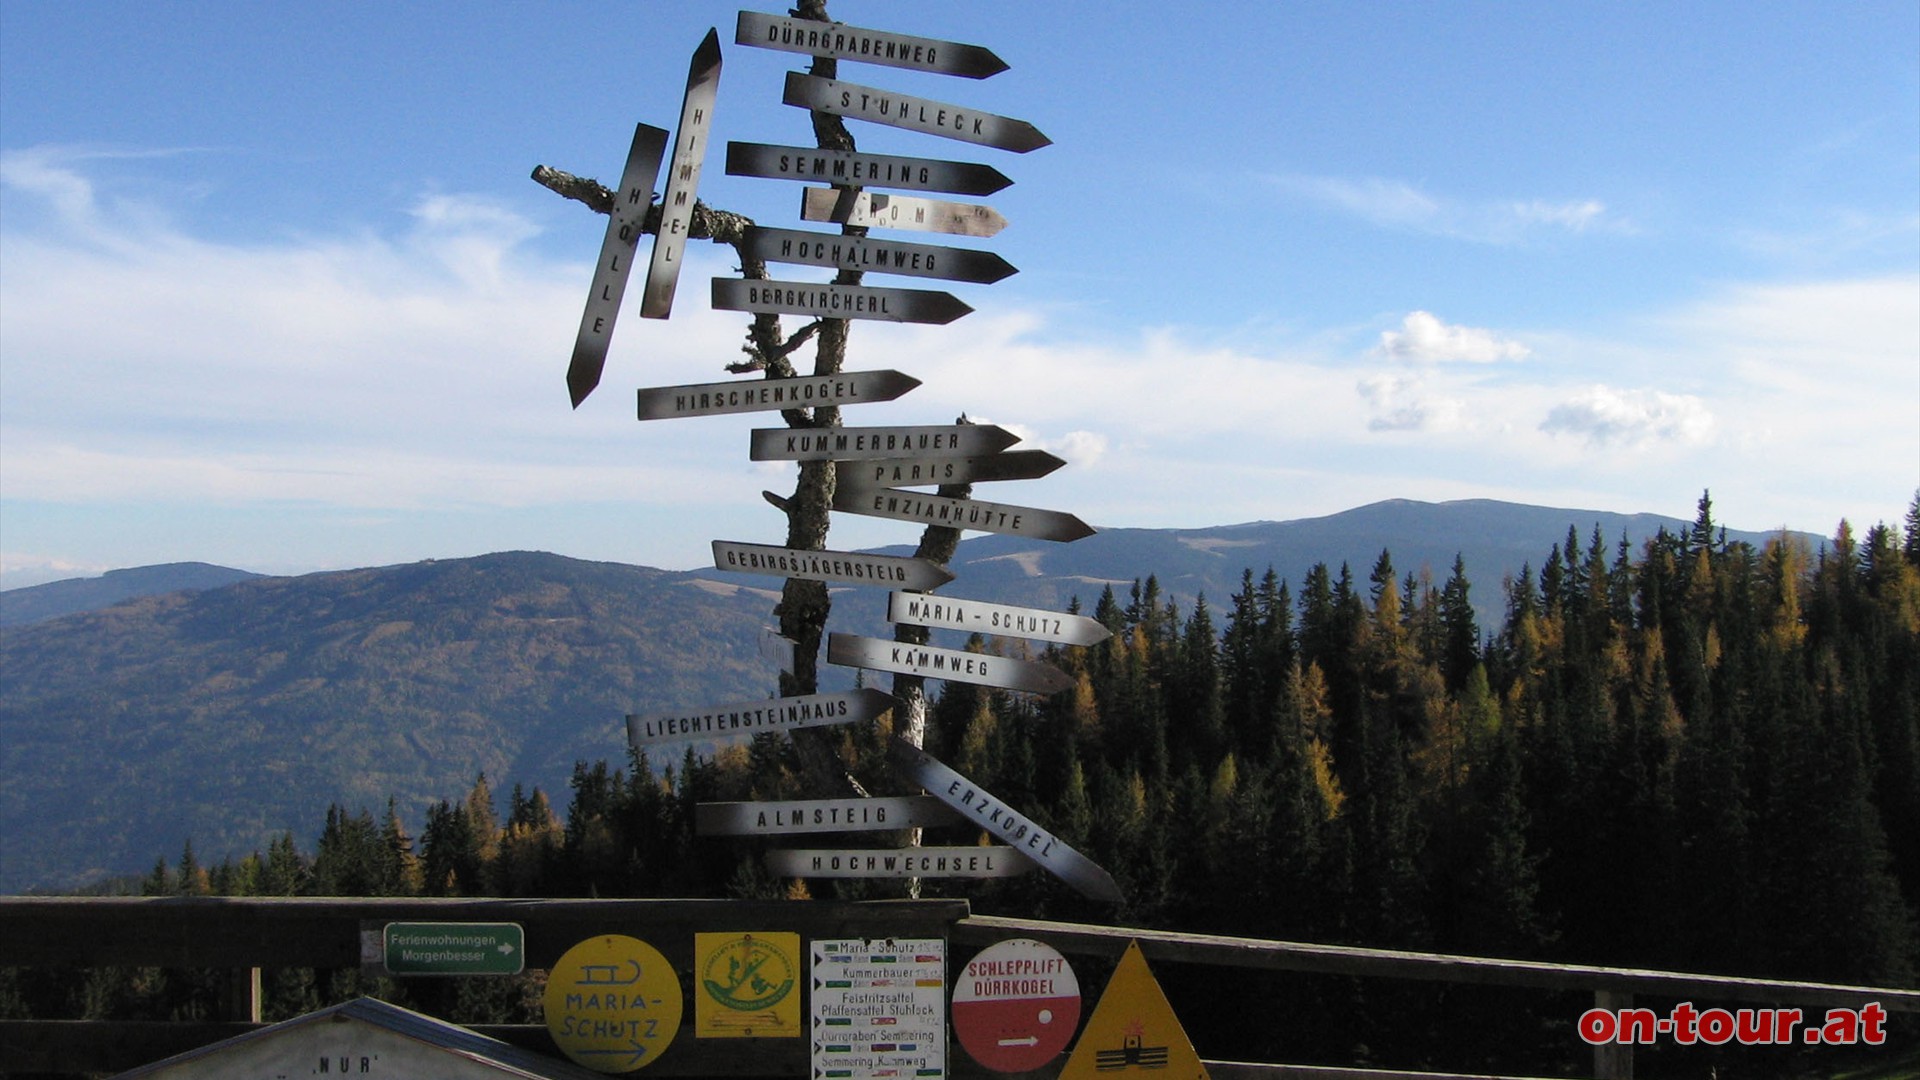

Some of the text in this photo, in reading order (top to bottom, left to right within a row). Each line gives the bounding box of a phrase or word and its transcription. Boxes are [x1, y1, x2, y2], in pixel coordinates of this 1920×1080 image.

[768, 22, 938, 65] DÜRRGRABENWEG
[840, 91, 984, 136] STUHLECK
[780, 155, 930, 184] SEMMERING
[664, 107, 704, 263] HIMMEL
[869, 203, 926, 224] ROM
[781, 239, 936, 271] HOCHALMWEG
[749, 287, 890, 314] BERGKIRCHERL
[676, 381, 859, 411] HIRSCHENKOGEL
[786, 433, 960, 453] KUMMERBAUER
[875, 463, 954, 482] PARIS
[874, 494, 1022, 530] ENZIANHÜTTE
[726, 550, 906, 582] GEBIRGSJÄGERSTEIG
[908, 600, 965, 624] MARIA
[991, 611, 1062, 636] SCHUTZ
[891, 648, 989, 677] KAMMWEG
[645, 701, 849, 738] LIECHTENSTEINHAUS
[757, 807, 887, 827] ALMSTEIG
[812, 855, 995, 873] HOCHWECHSEL
[390, 934, 497, 949] Ferienwohnungen
[840, 942, 869, 953] Maria
[402, 949, 487, 963] Morgenbesser
[842, 968, 913, 979] Kummerbauer
[968, 958, 1064, 978] SCHLEPPLIFT
[974, 977, 1056, 996] DÜRRKOGEL
[565, 992, 663, 1011] MARIA-
[559, 1015, 660, 1038] SCHUTZ
